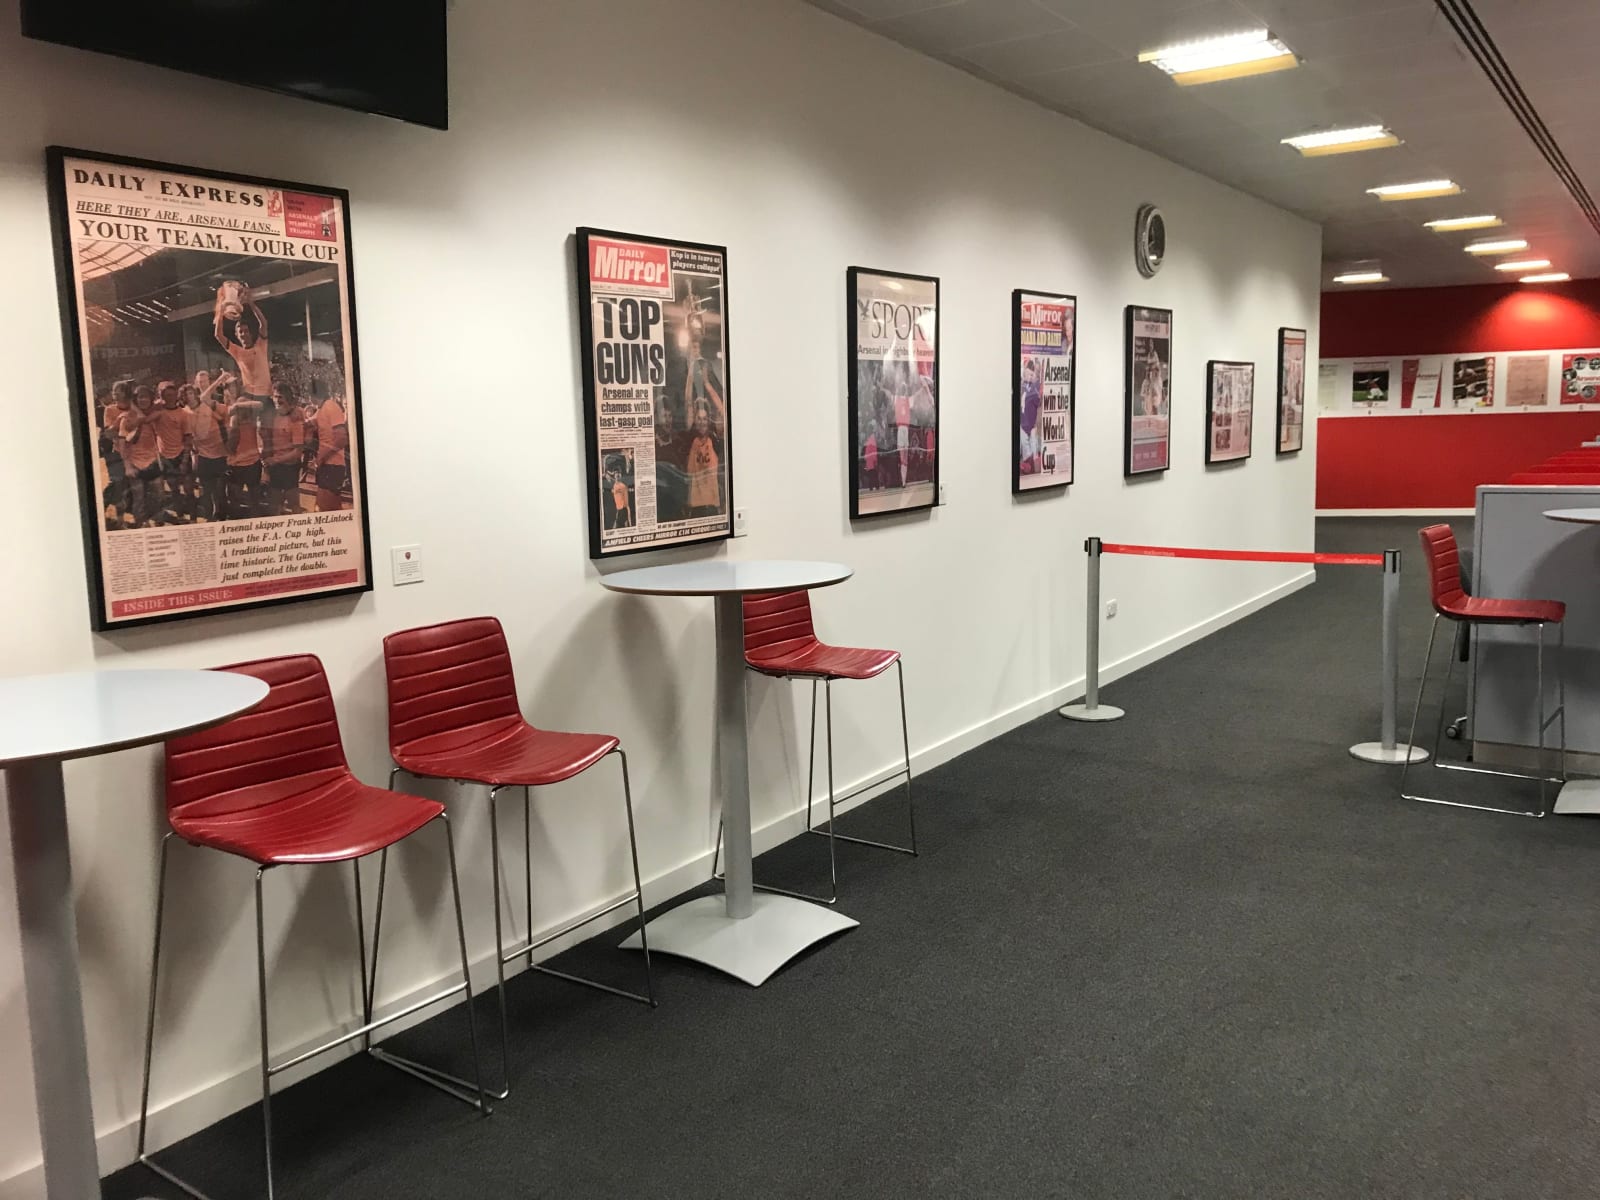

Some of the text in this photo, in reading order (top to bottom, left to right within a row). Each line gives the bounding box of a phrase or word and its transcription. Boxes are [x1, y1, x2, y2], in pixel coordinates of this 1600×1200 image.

[73, 168, 146, 191] DAILY
[160, 180, 264, 207] EXPRESS
[76, 200, 113, 214] HERE
[117, 205, 150, 218] THEY
[155, 210, 182, 222] ARE,
[187, 214, 240, 229] ARSENAL
[78, 219, 339, 261] YOUR TEAM, YOUR CUP
[618, 248, 646, 259] DAILY
[594, 246, 666, 284] Mirror
[672, 260, 696, 270] players
[597, 297, 661, 341] TOP
[1030, 304, 1062, 325] Mirror
[858, 344, 882, 356] Arsenal
[596, 341, 664, 385] GUNS
[1044, 357, 1070, 382] Arsenal
[603, 387, 648, 399] Arsenal are
[1043, 388, 1069, 411] win the
[601, 401, 651, 413] champs with
[600, 415, 653, 428] last-gasp goal
[1042, 416, 1065, 441] World
[1042, 446, 1056, 474] Cup
[218, 512, 354, 534] Arsenal skipper Frank McLintock
[219, 536, 244, 546] raises
[246, 533, 260, 543] the
[284, 530, 302, 540] Cup
[306, 527, 327, 538] high.
[220, 536, 342, 558] A traditional picture, but this
[604, 536, 632, 547] ANFIELD
[655, 530, 678, 540] MIRROR
[220, 547, 348, 570] time historic. The Gunners have
[220, 561, 328, 583] just completed the double.
[123, 590, 232, 613] INSIDE THIS ISSUE:
